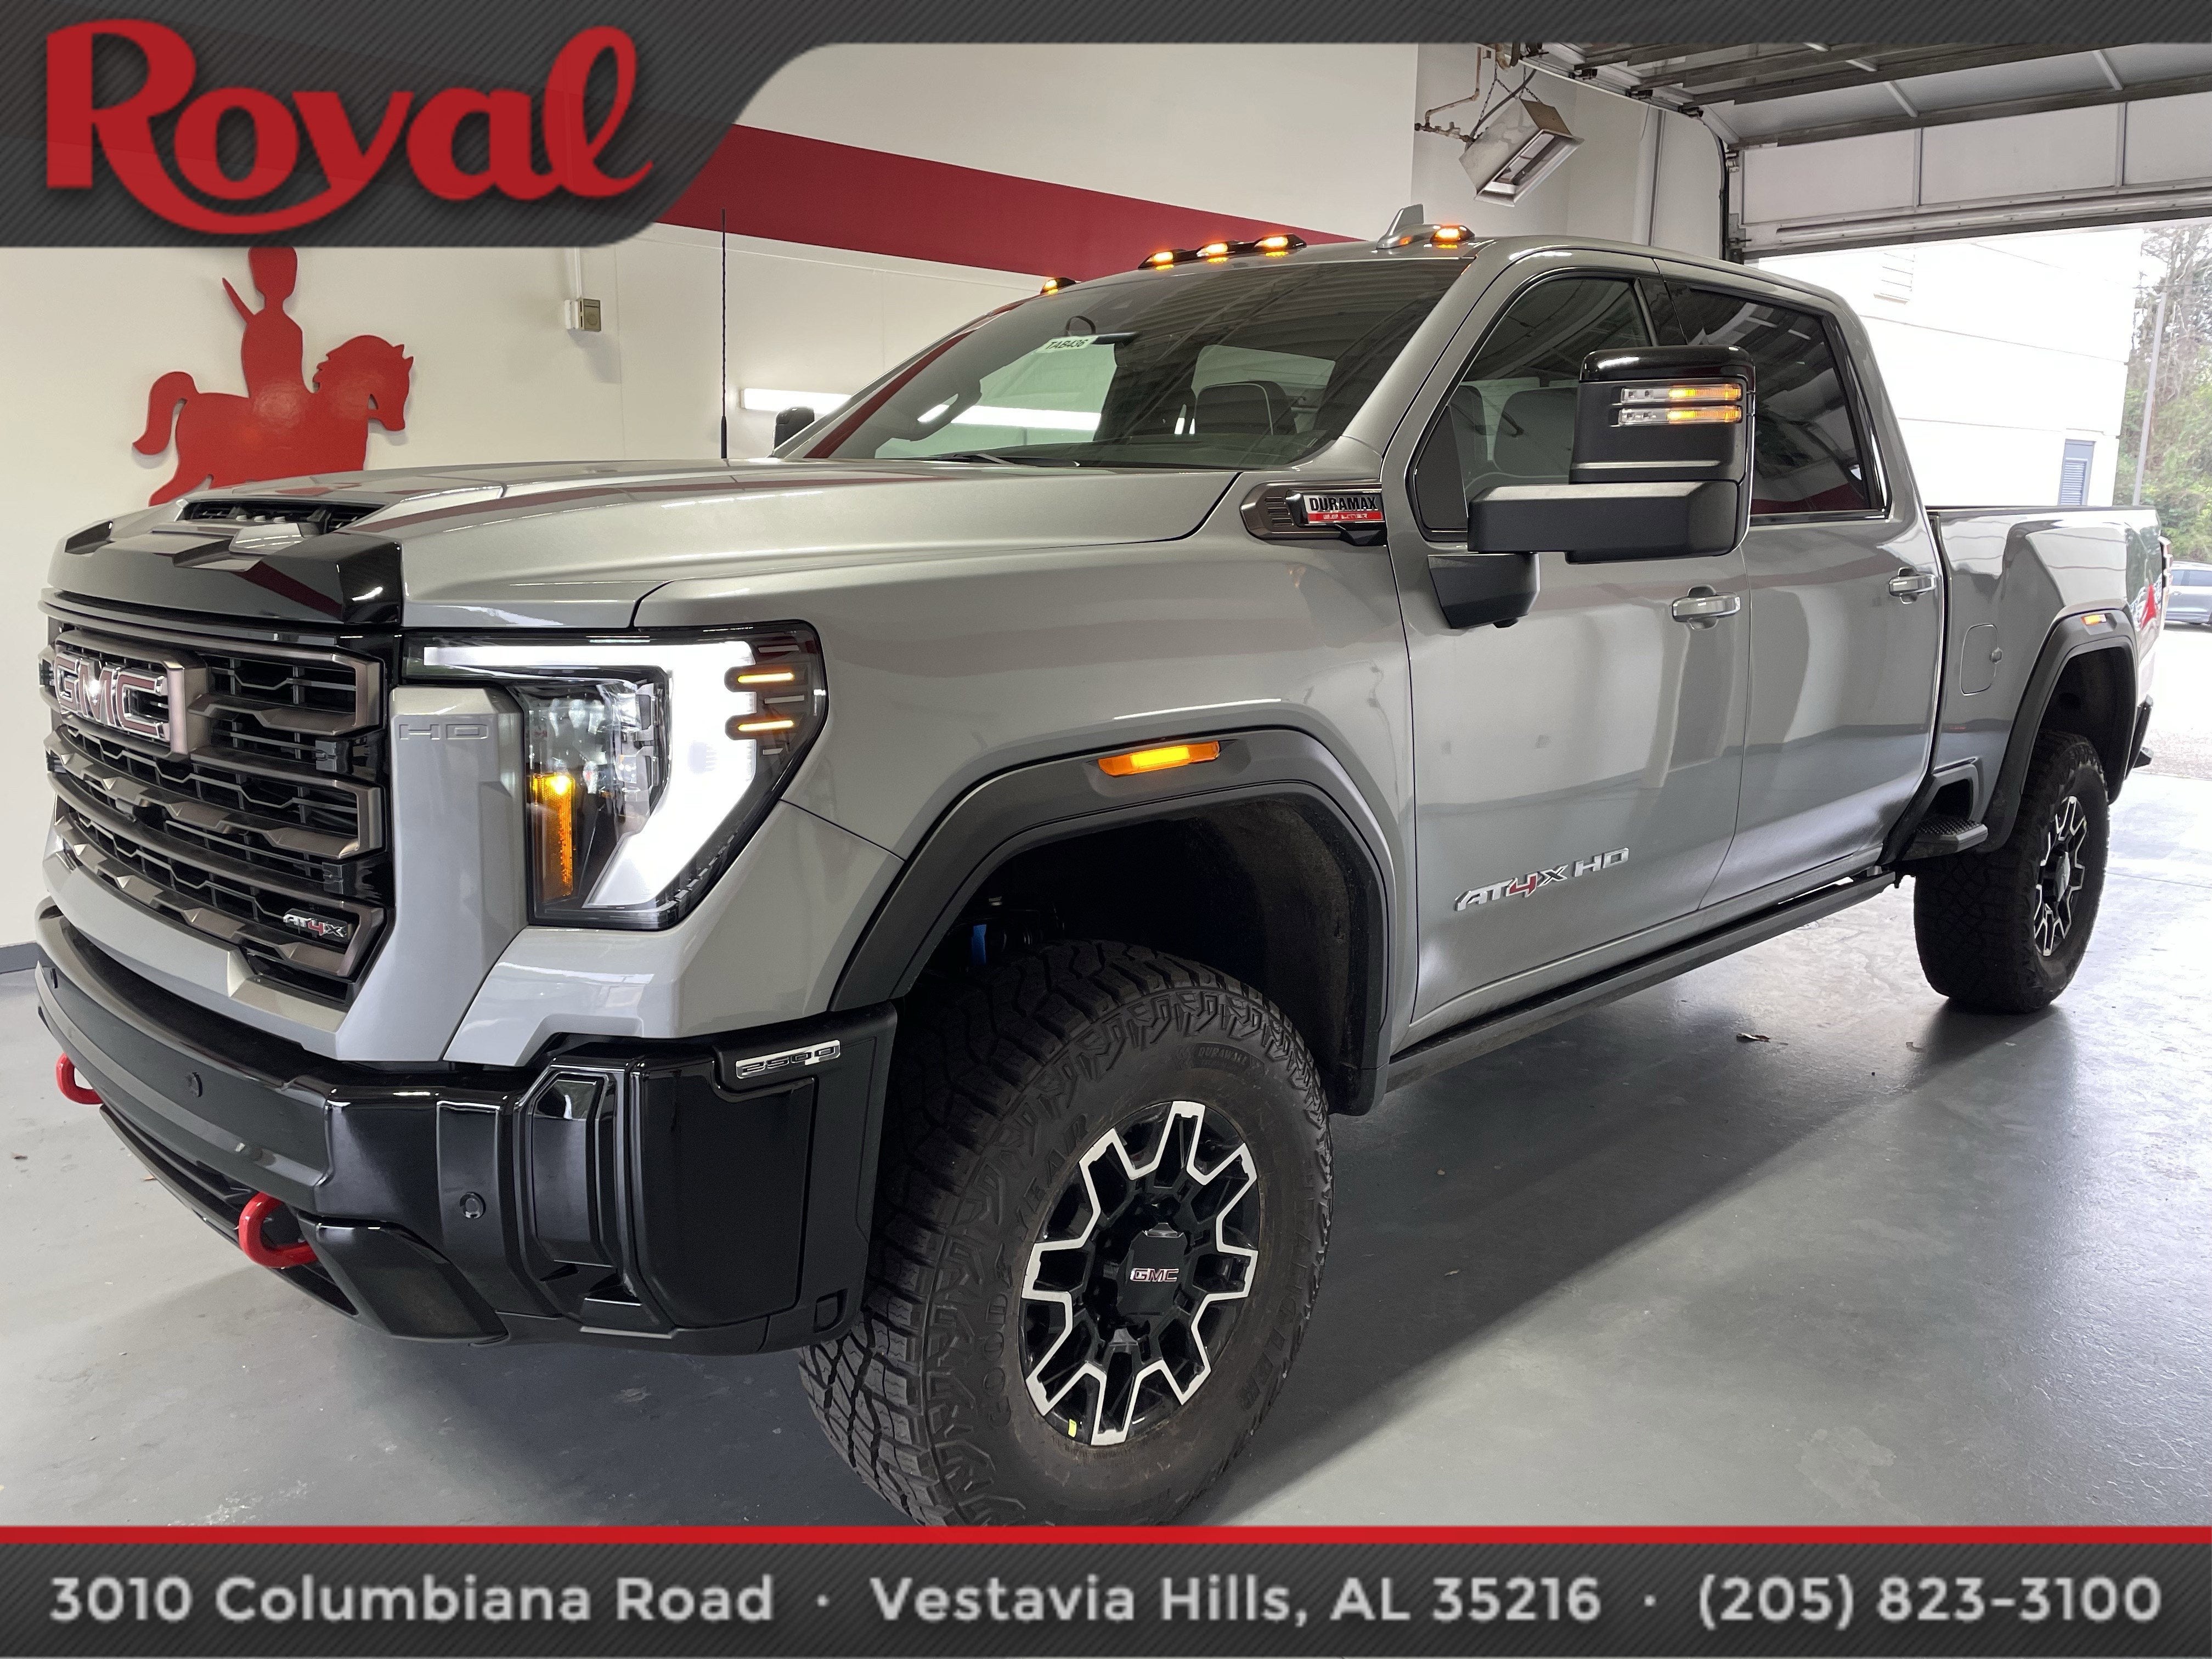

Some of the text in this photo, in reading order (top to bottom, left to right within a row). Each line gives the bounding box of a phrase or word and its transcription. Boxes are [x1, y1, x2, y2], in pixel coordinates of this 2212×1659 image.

[1308, 496, 1378, 512] DURAMAX
[55, 653, 167, 740] GMC
[399, 724, 489, 741] HD
[1572, 847, 1629, 878] HD
[1130, 1267, 1179, 1282] GMC
